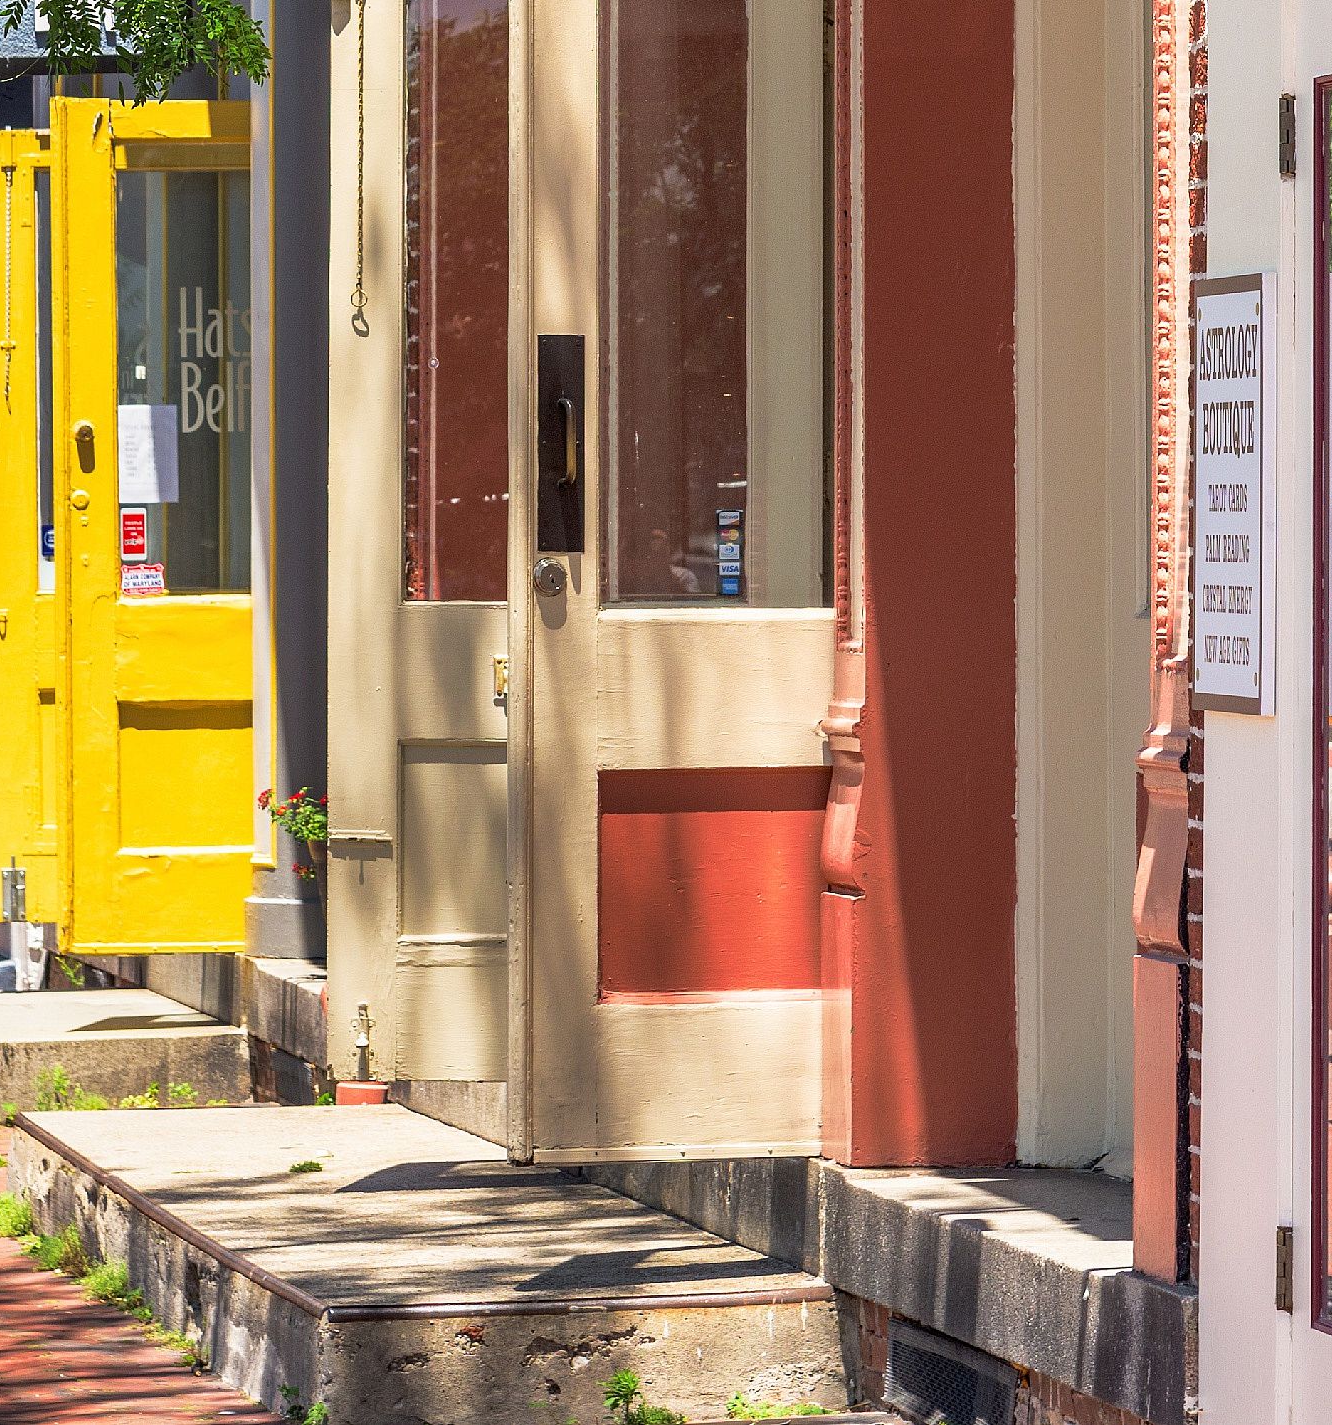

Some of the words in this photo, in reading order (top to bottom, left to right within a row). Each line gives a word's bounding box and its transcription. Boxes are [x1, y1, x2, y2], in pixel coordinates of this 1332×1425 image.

[1200, 324, 1257, 381] ASTROLOGY
[181, 360, 251, 434] Belf
[1203, 401, 1254, 458] BOUTIQUE
[1208, 484, 1227, 512] TAROT
[1228, 483, 1248, 513] CARDS
[1205, 534, 1221, 563] PALM
[1223, 534, 1250, 563] READING
[721, 565, 739, 573] VISA
[1202, 584, 1227, 614] CRYSTAL
[1228, 586, 1253, 614] ENERGY
[1204, 635, 1218, 663] NEW
[1219, 636, 1231, 664] AGE
[1232, 636, 1250, 666] GIFTS
